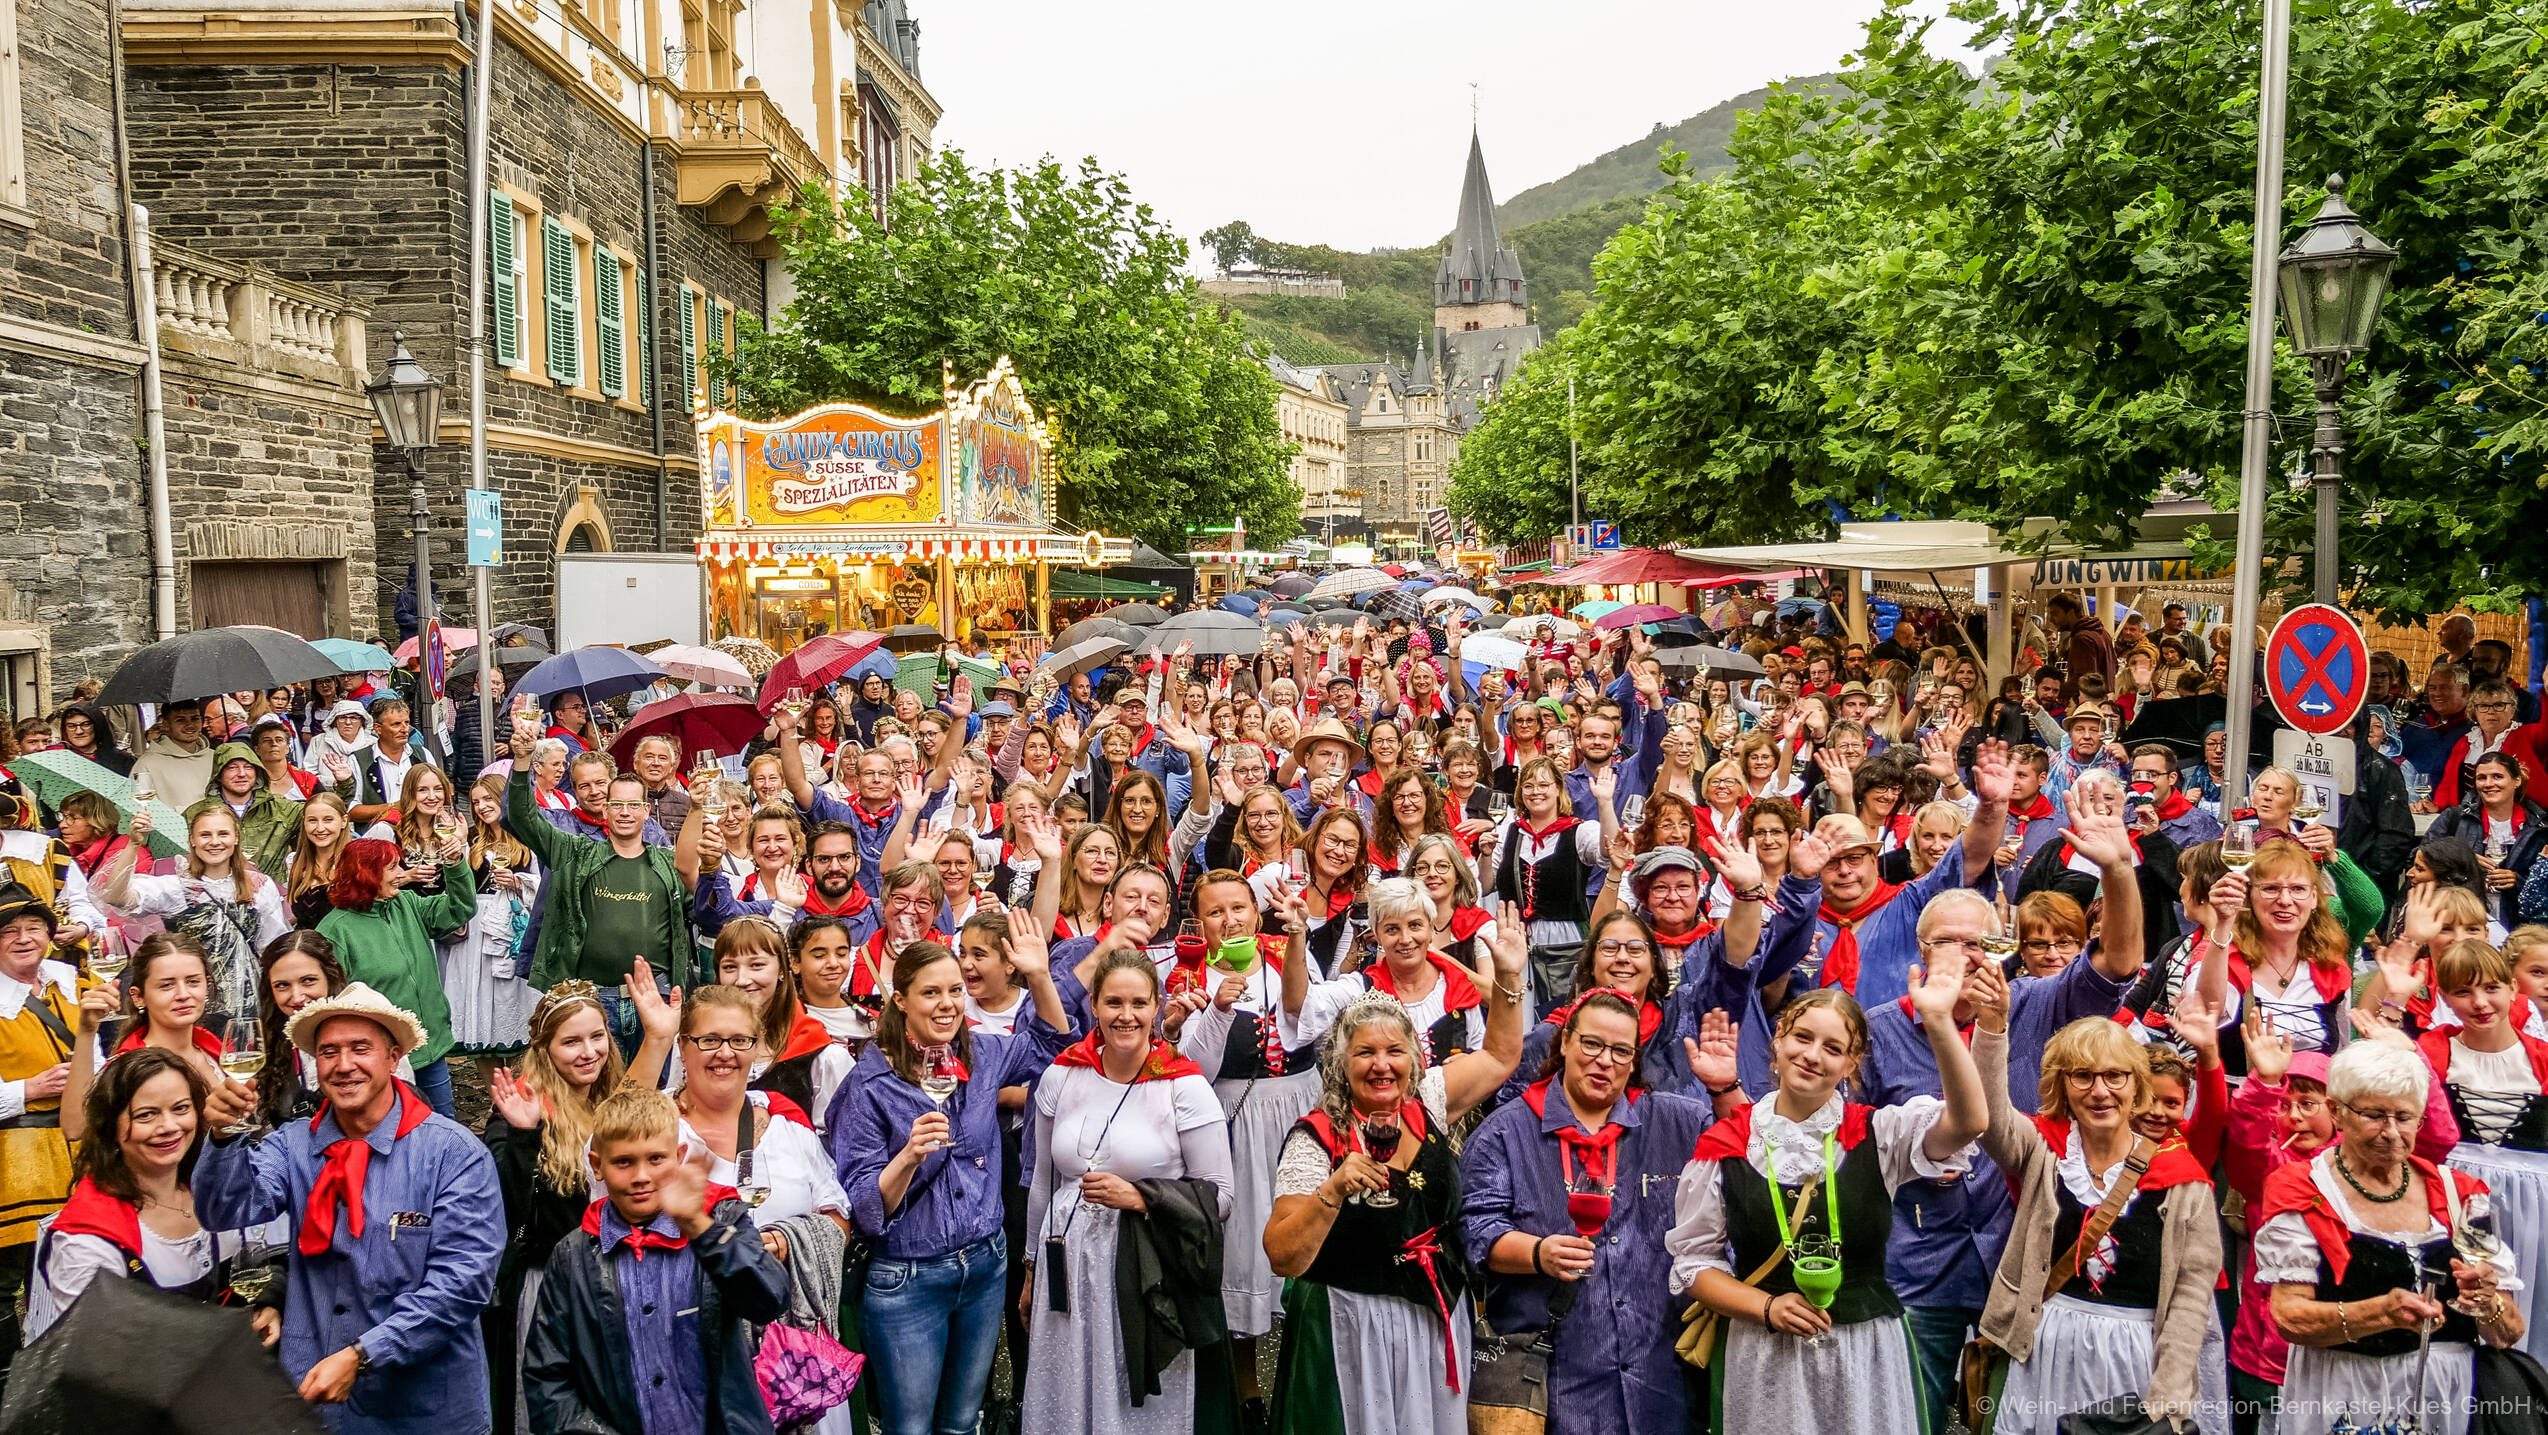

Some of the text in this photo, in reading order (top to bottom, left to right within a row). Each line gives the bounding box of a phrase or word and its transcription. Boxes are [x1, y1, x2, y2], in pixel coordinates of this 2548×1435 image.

[815, 460, 865, 475] SÜSSE
[783, 474, 898, 505] SPEZIALITÄTEN
[469, 498, 489, 520] WC
[2304, 742, 2324, 757] AB
[2296, 758, 2304, 771] ab
[594, 886, 653, 902] Winzerkittel
